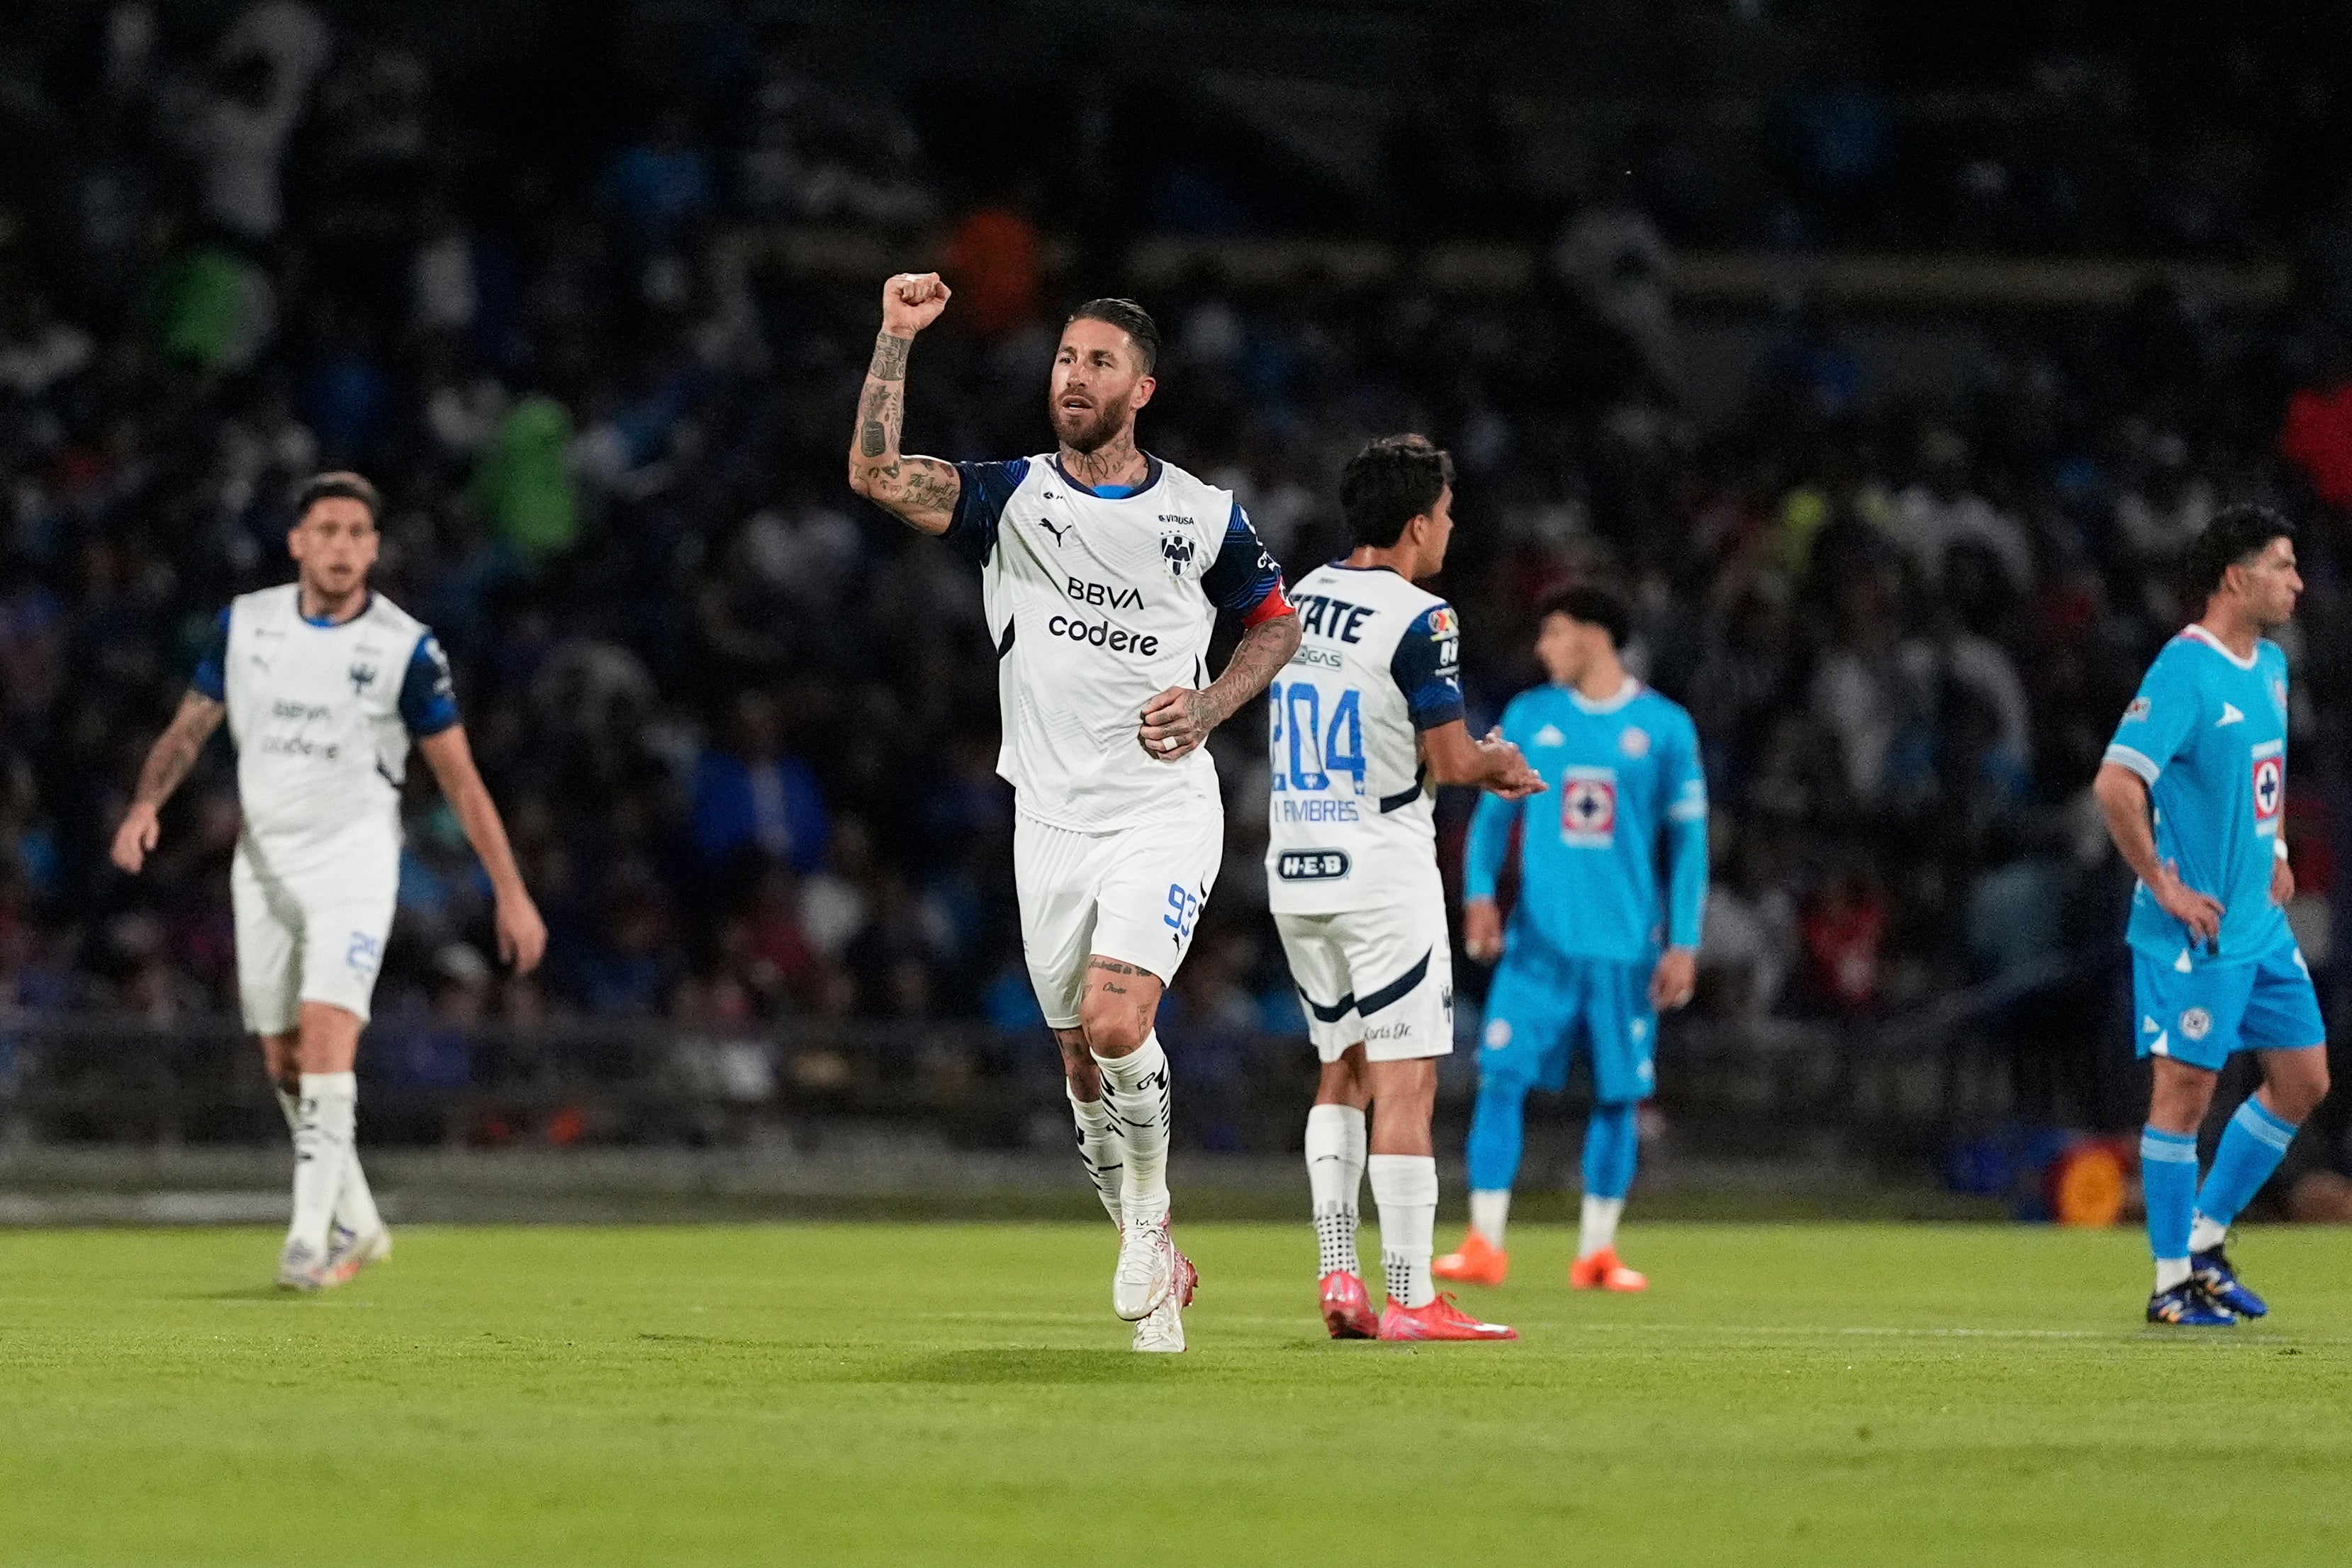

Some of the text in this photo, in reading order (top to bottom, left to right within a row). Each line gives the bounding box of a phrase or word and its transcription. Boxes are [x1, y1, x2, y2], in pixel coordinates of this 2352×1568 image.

[1068, 576, 1144, 610] BBVA
[1048, 615, 1158, 656] codere
[1163, 883, 1197, 938] 93
